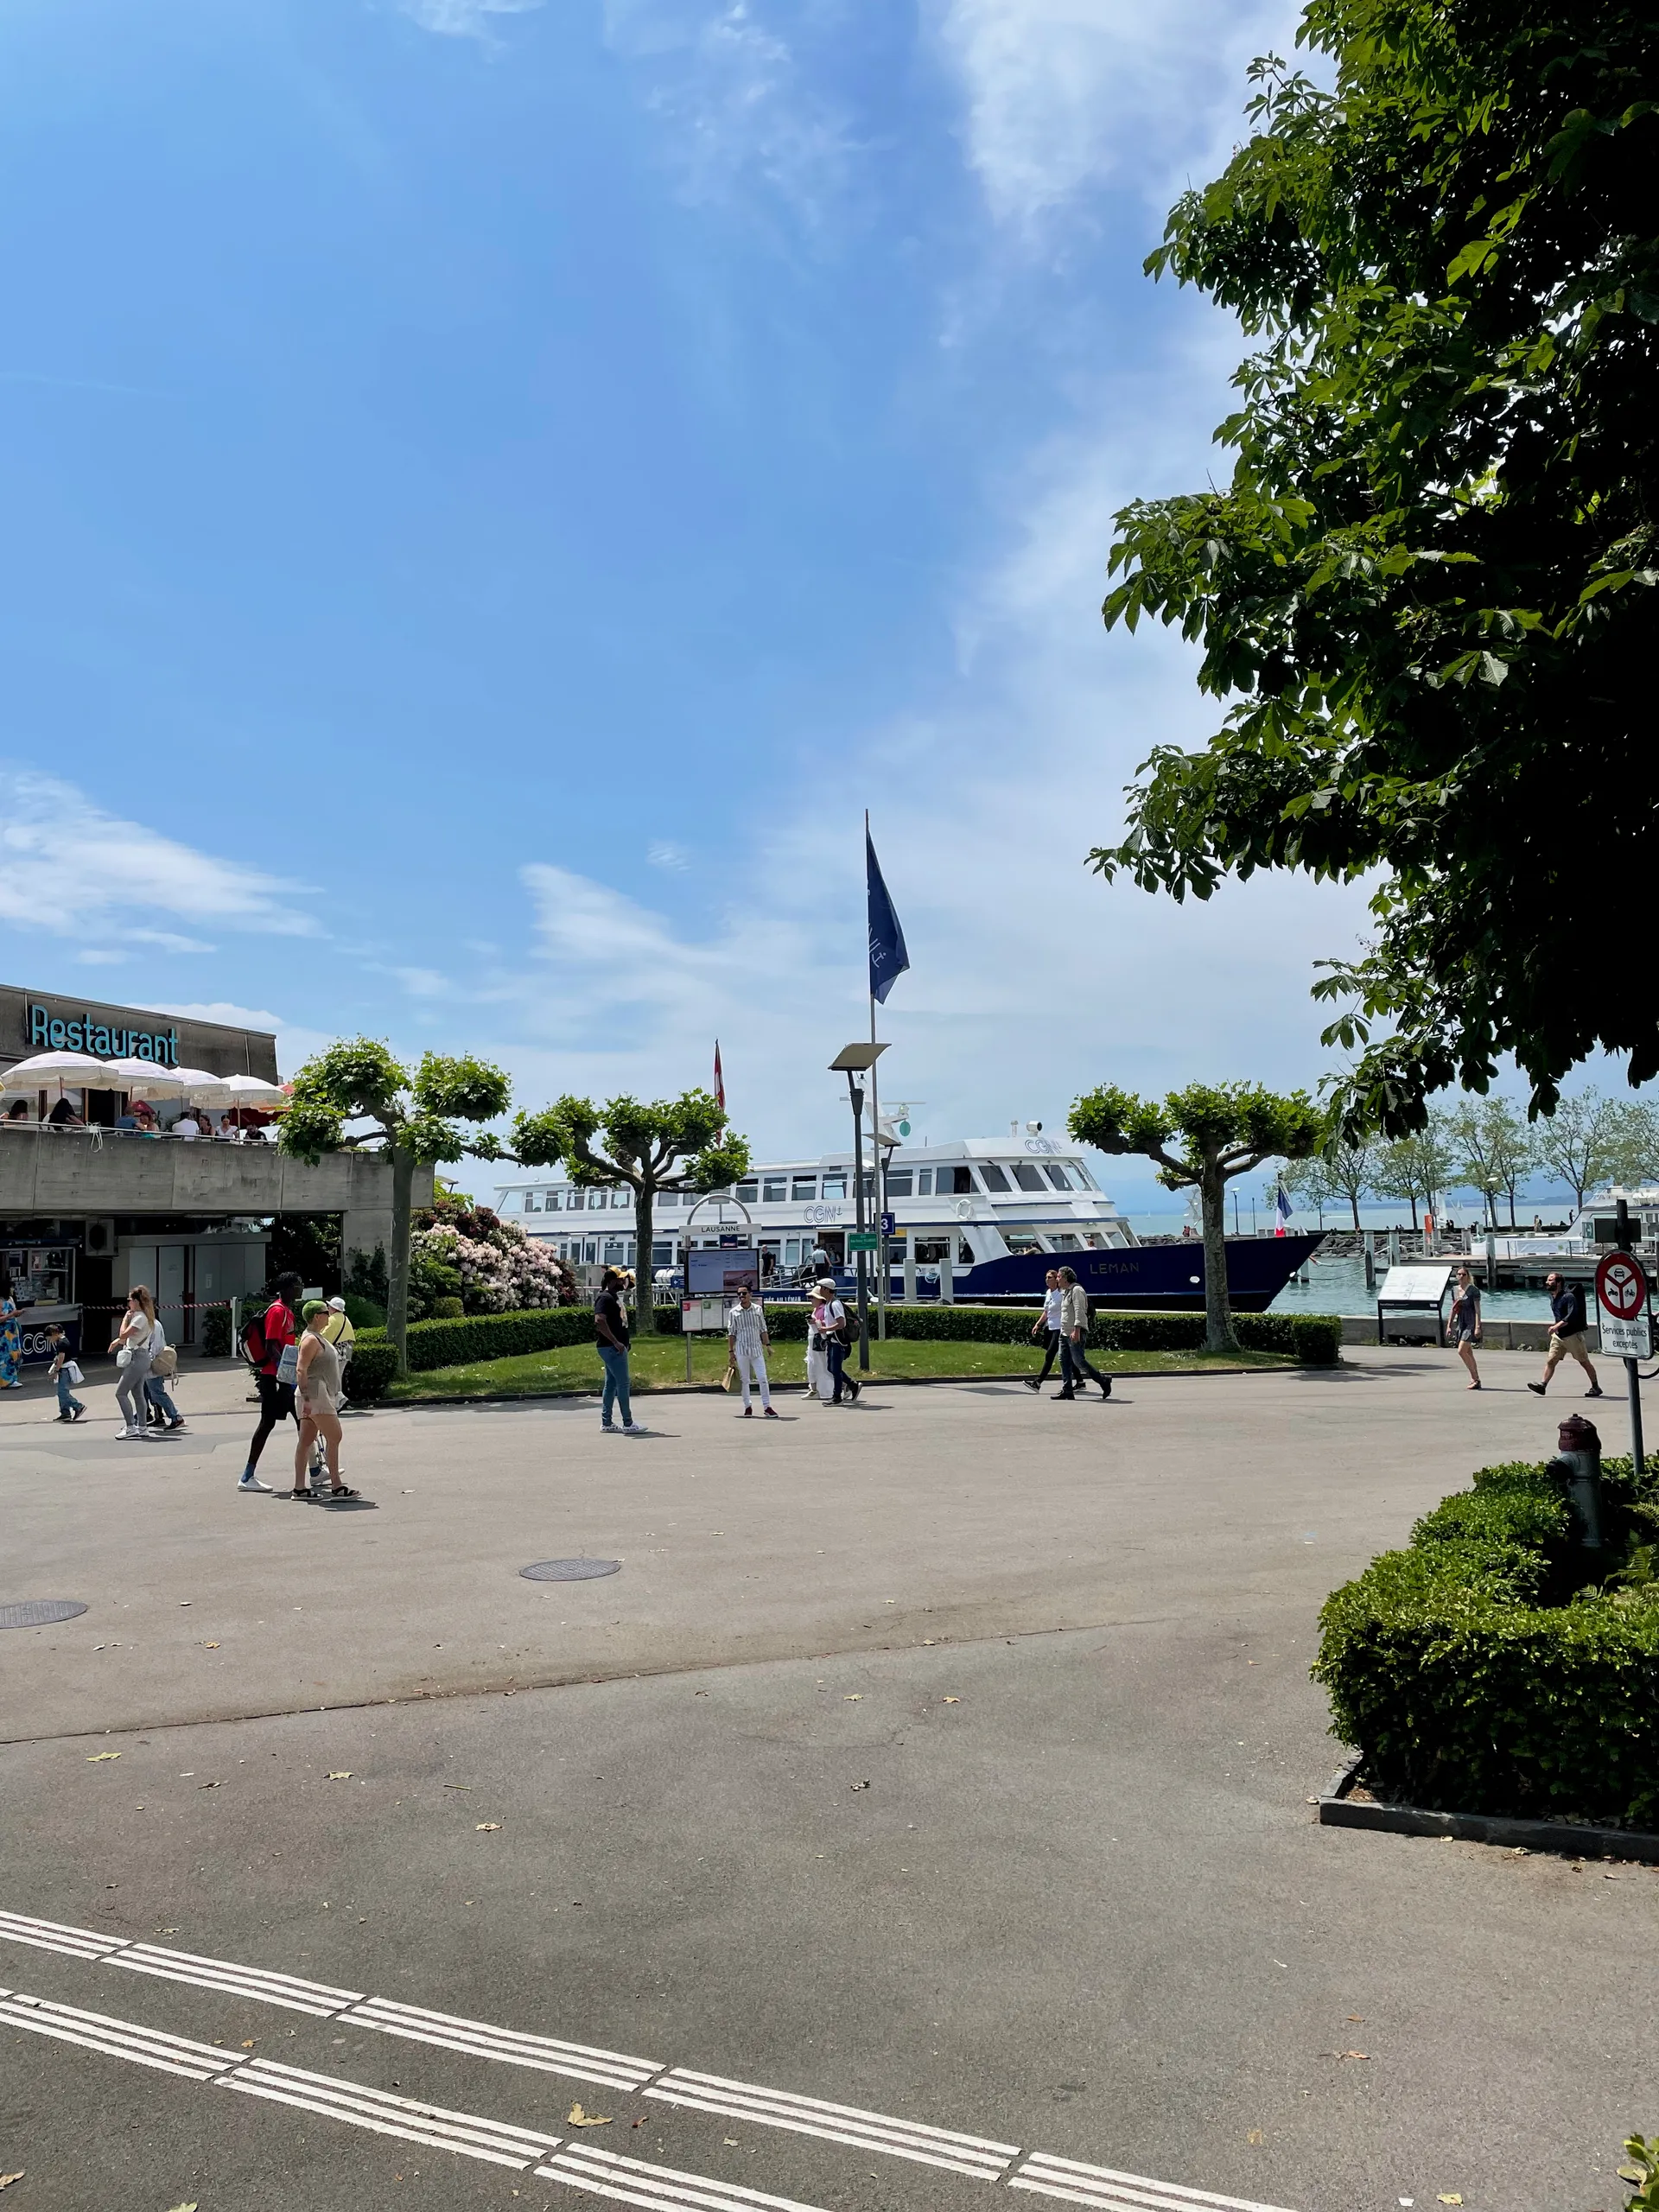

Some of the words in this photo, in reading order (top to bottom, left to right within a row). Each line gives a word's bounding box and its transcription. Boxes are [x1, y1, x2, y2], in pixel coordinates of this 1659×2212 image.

[31, 1004, 179, 1065] Restaurant
[1025, 1139, 1062, 1154] CGN
[804, 1205, 836, 1224] CGN
[880, 1218, 889, 1230] 3
[1602, 1324, 1625, 1336] Services
[1626, 1326, 1648, 1338] publics
